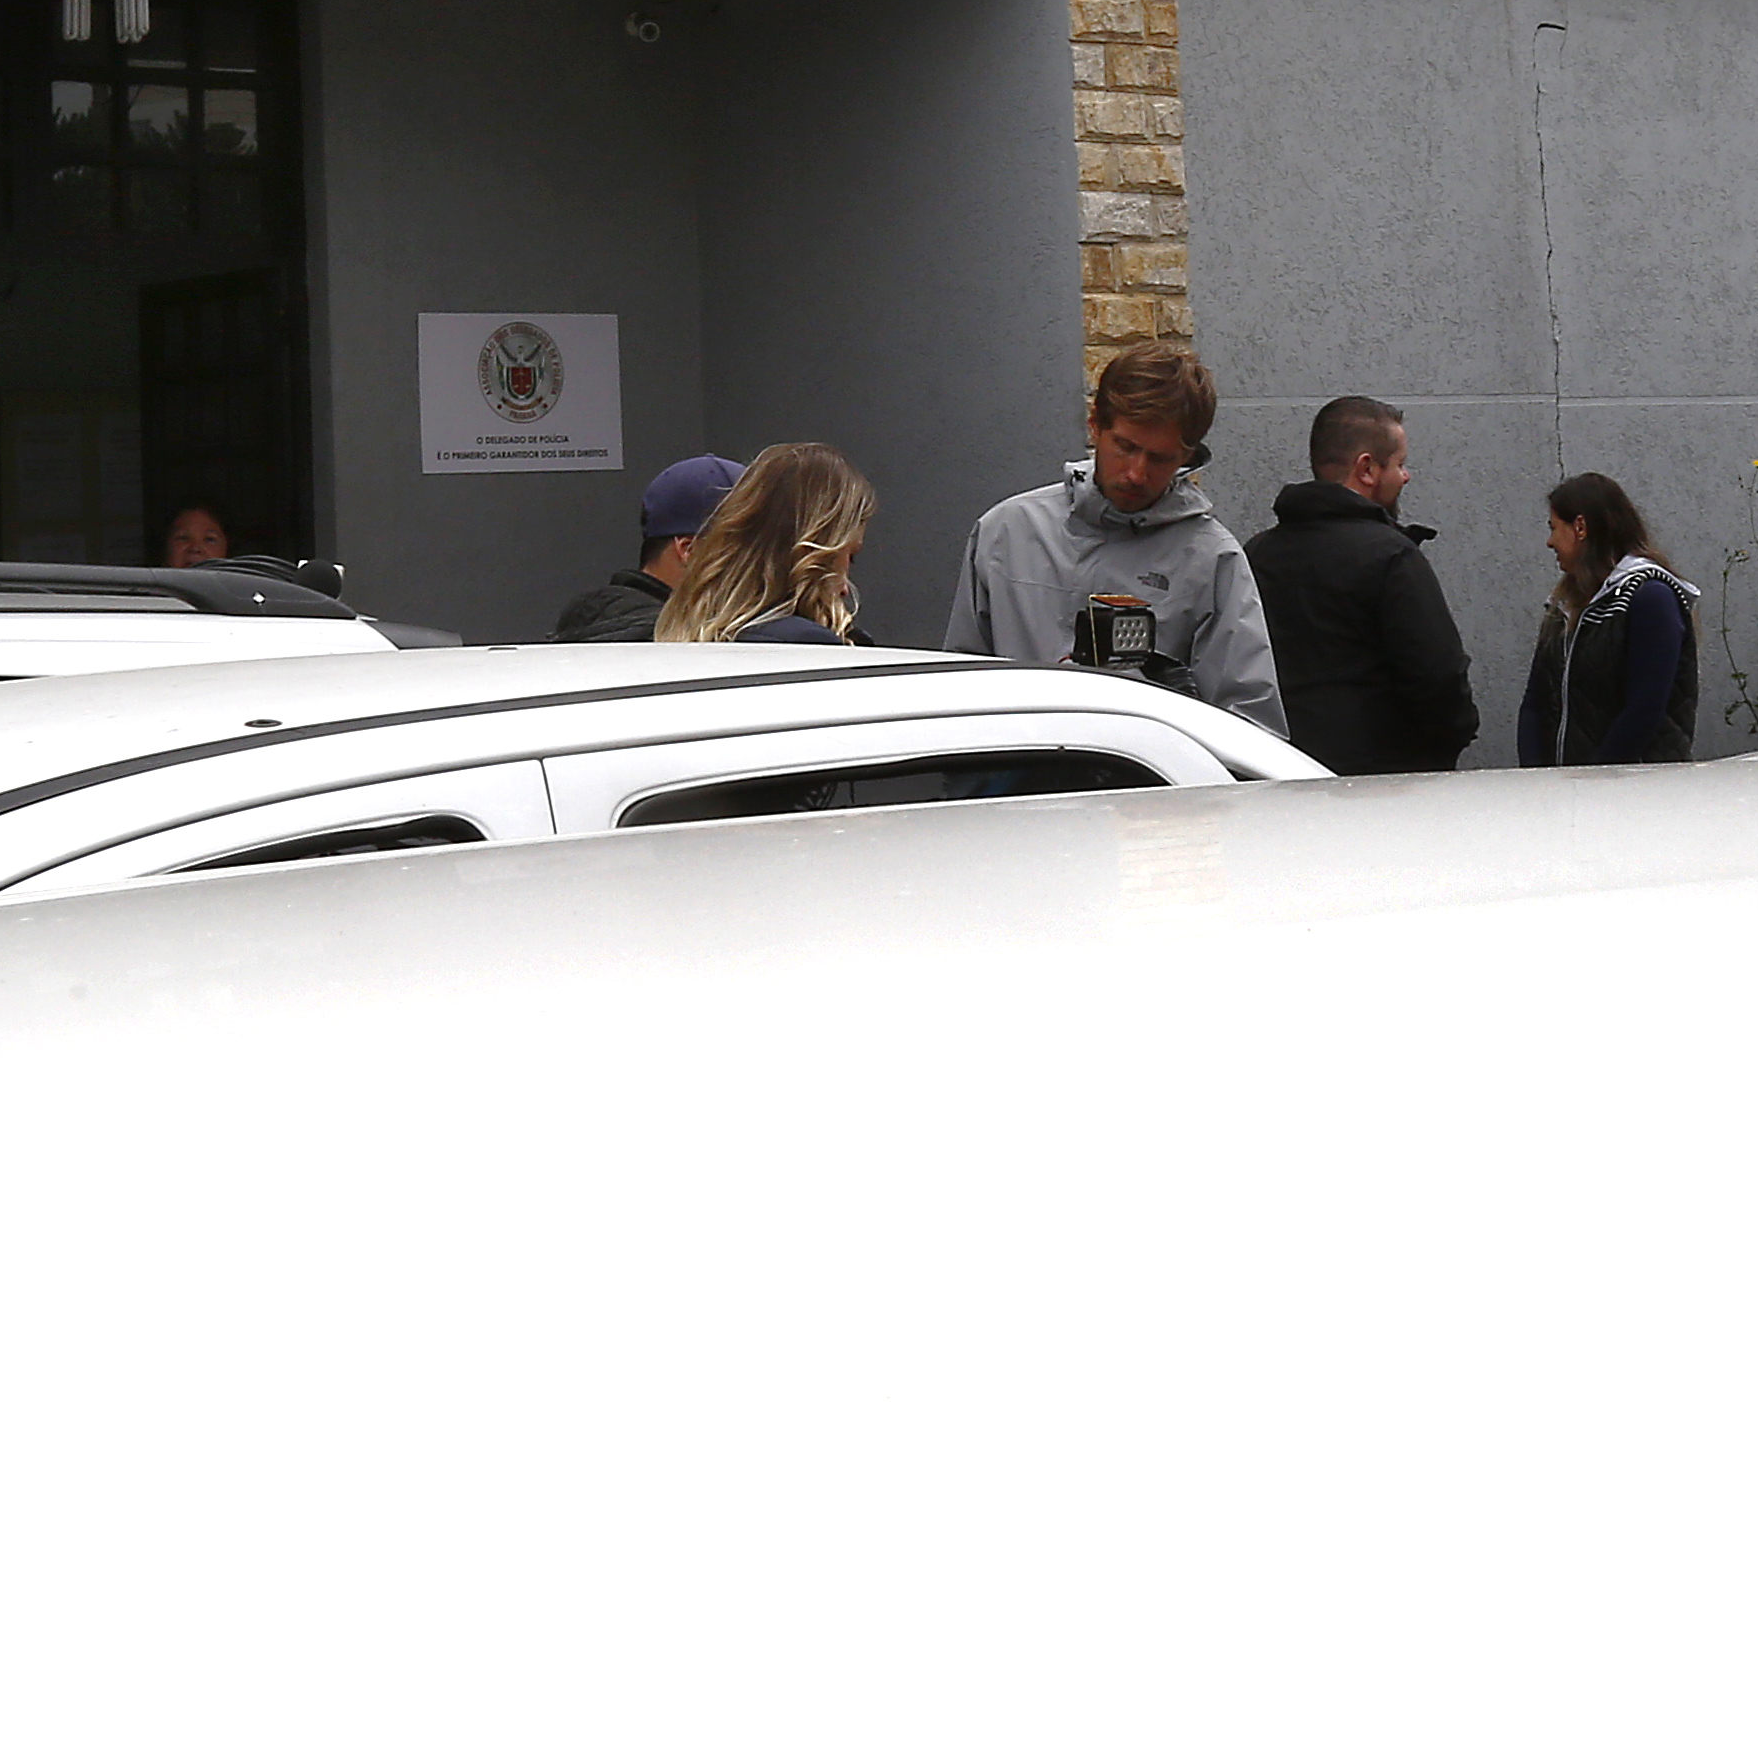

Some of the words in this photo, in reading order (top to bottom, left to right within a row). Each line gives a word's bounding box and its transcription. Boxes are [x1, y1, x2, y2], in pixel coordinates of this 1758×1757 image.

[485, 435, 526, 445] DELEGADO
[528, 435, 538, 444] DE
[452, 451, 488, 460] PRIMEIRO
[489, 449, 539, 459] GARANTIDOR
[540, 449, 557, 458] DOS
[576, 448, 608, 458] DIREITOS
